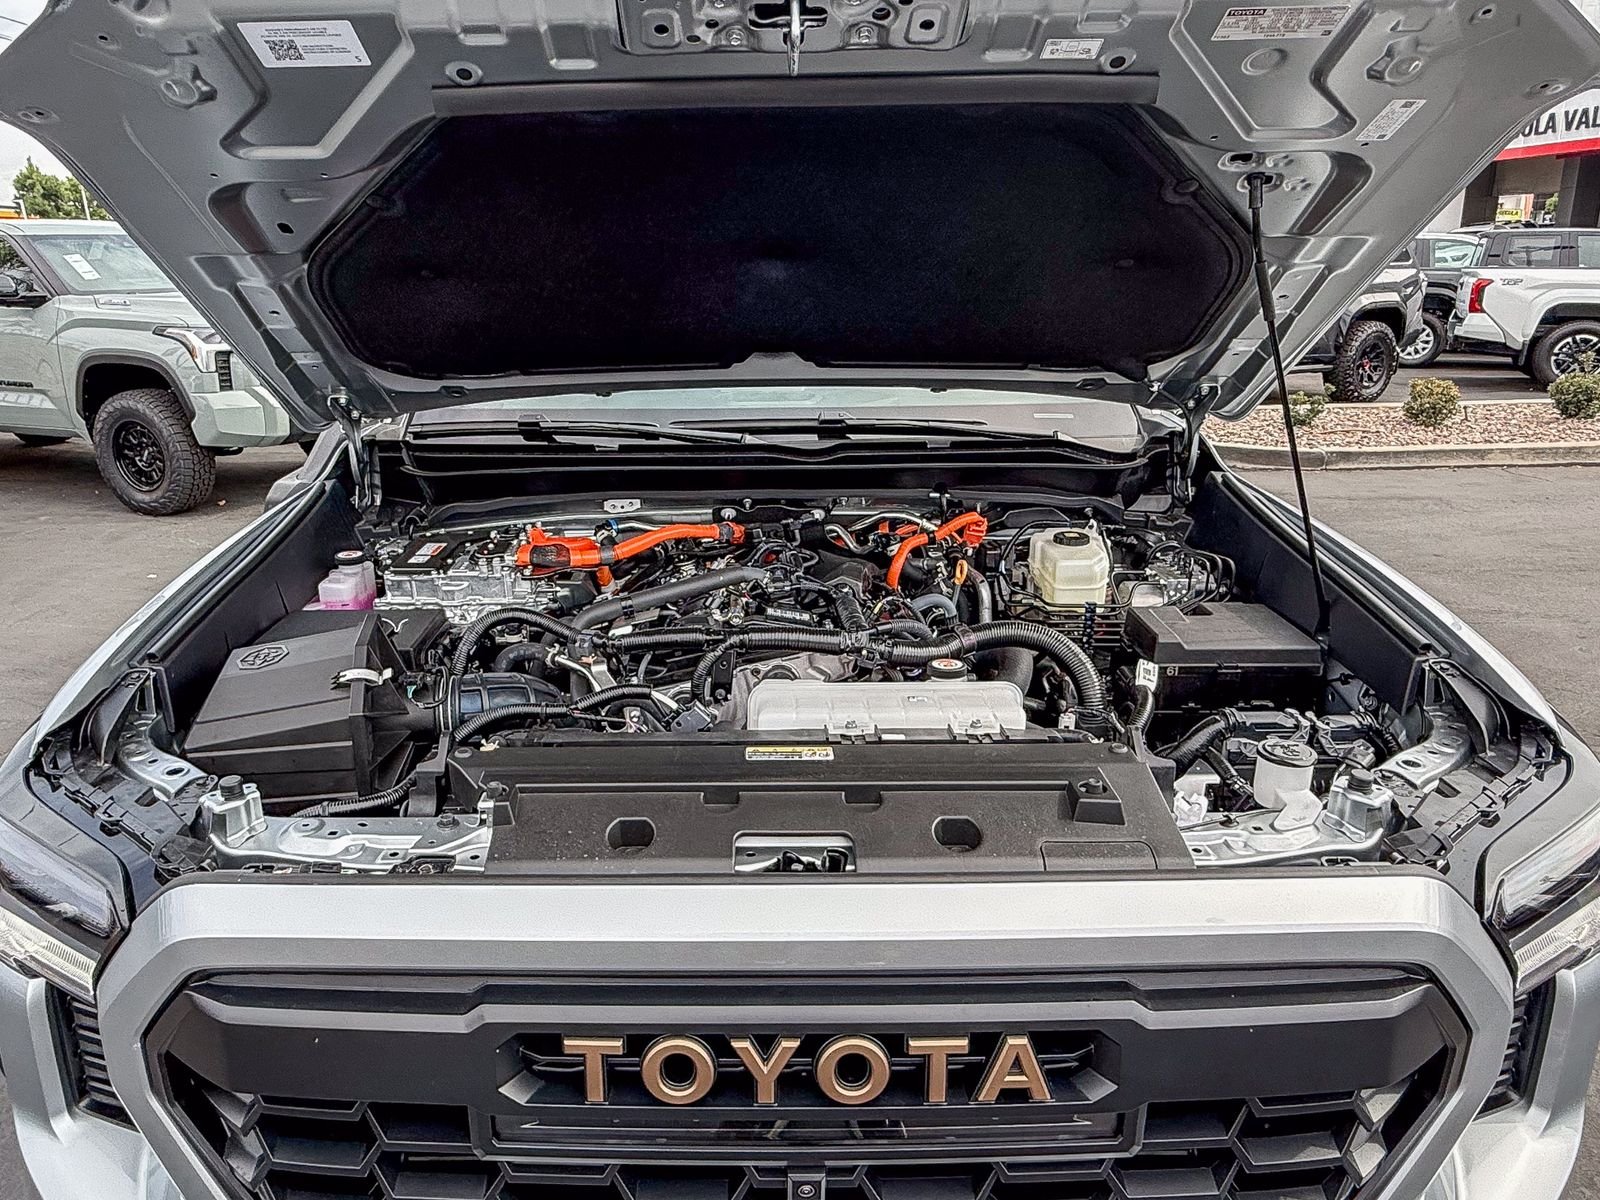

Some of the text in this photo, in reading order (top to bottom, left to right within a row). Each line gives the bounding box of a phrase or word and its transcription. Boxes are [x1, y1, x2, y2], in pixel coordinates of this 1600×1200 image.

[1564, 105, 1600, 132] VAL
[1166, 666, 1179, 677] 61
[562, 1034, 1054, 1105] TOYOTA
